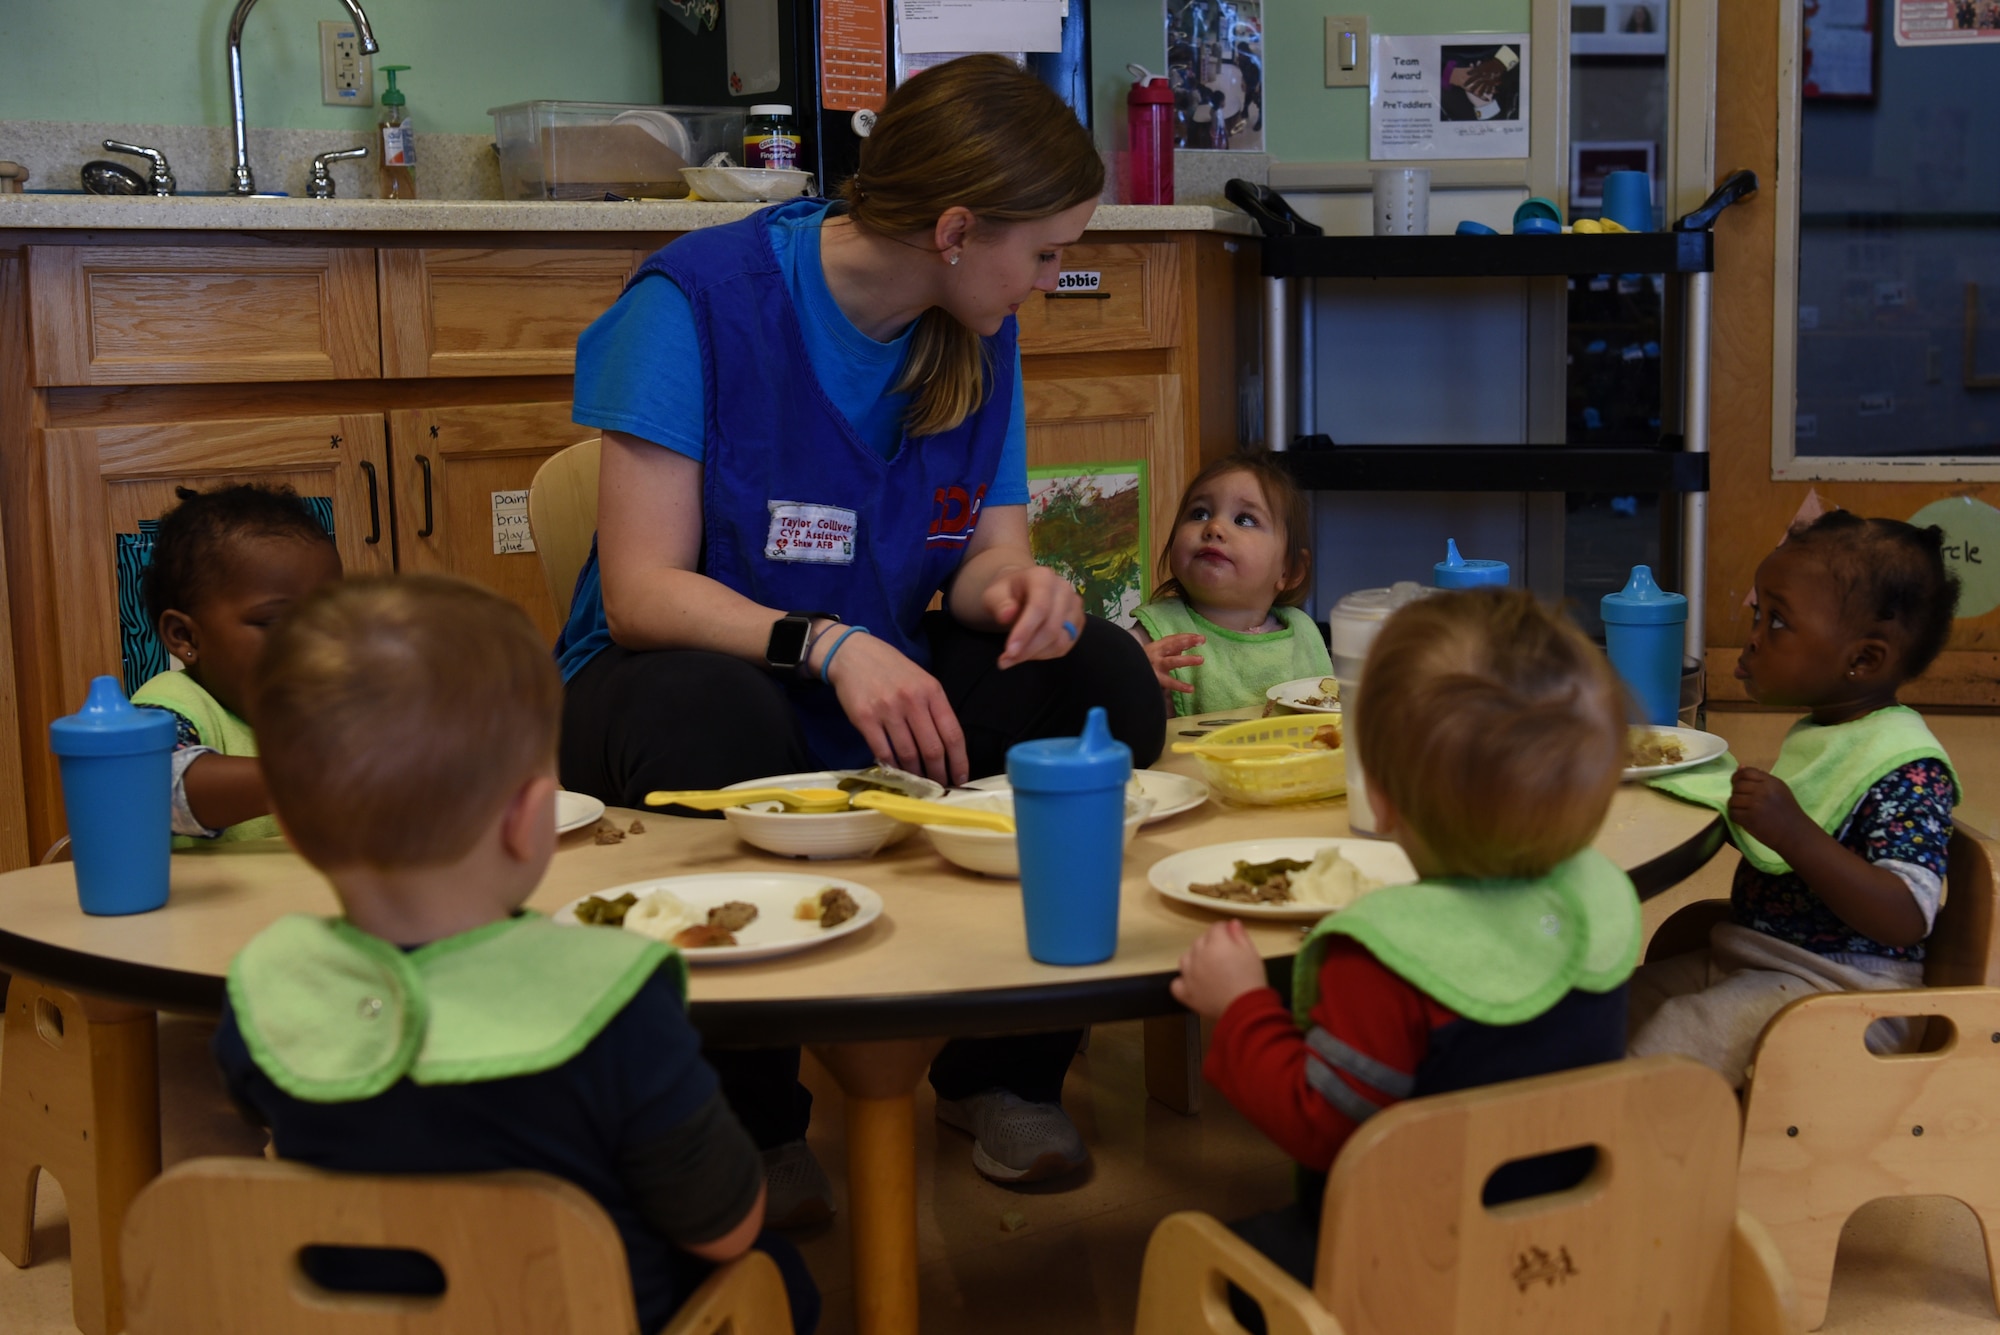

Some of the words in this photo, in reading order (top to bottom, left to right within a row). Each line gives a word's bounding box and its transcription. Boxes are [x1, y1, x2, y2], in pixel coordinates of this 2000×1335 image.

[1393, 57, 1420, 66] Team
[1390, 72, 1422, 81] Award
[1382, 101, 1432, 109] PreToddlers
[1058, 273, 1098, 287] ebbie
[496, 512, 529, 526] brus
[781, 516, 812, 530] Taylor
[817, 519, 852, 533] Colliver
[780, 528, 801, 539] CYP
[805, 530, 849, 543] Assistant
[500, 541, 525, 553] glue
[817, 540, 833, 550] AFB
[1941, 540, 1982, 564] rcle
